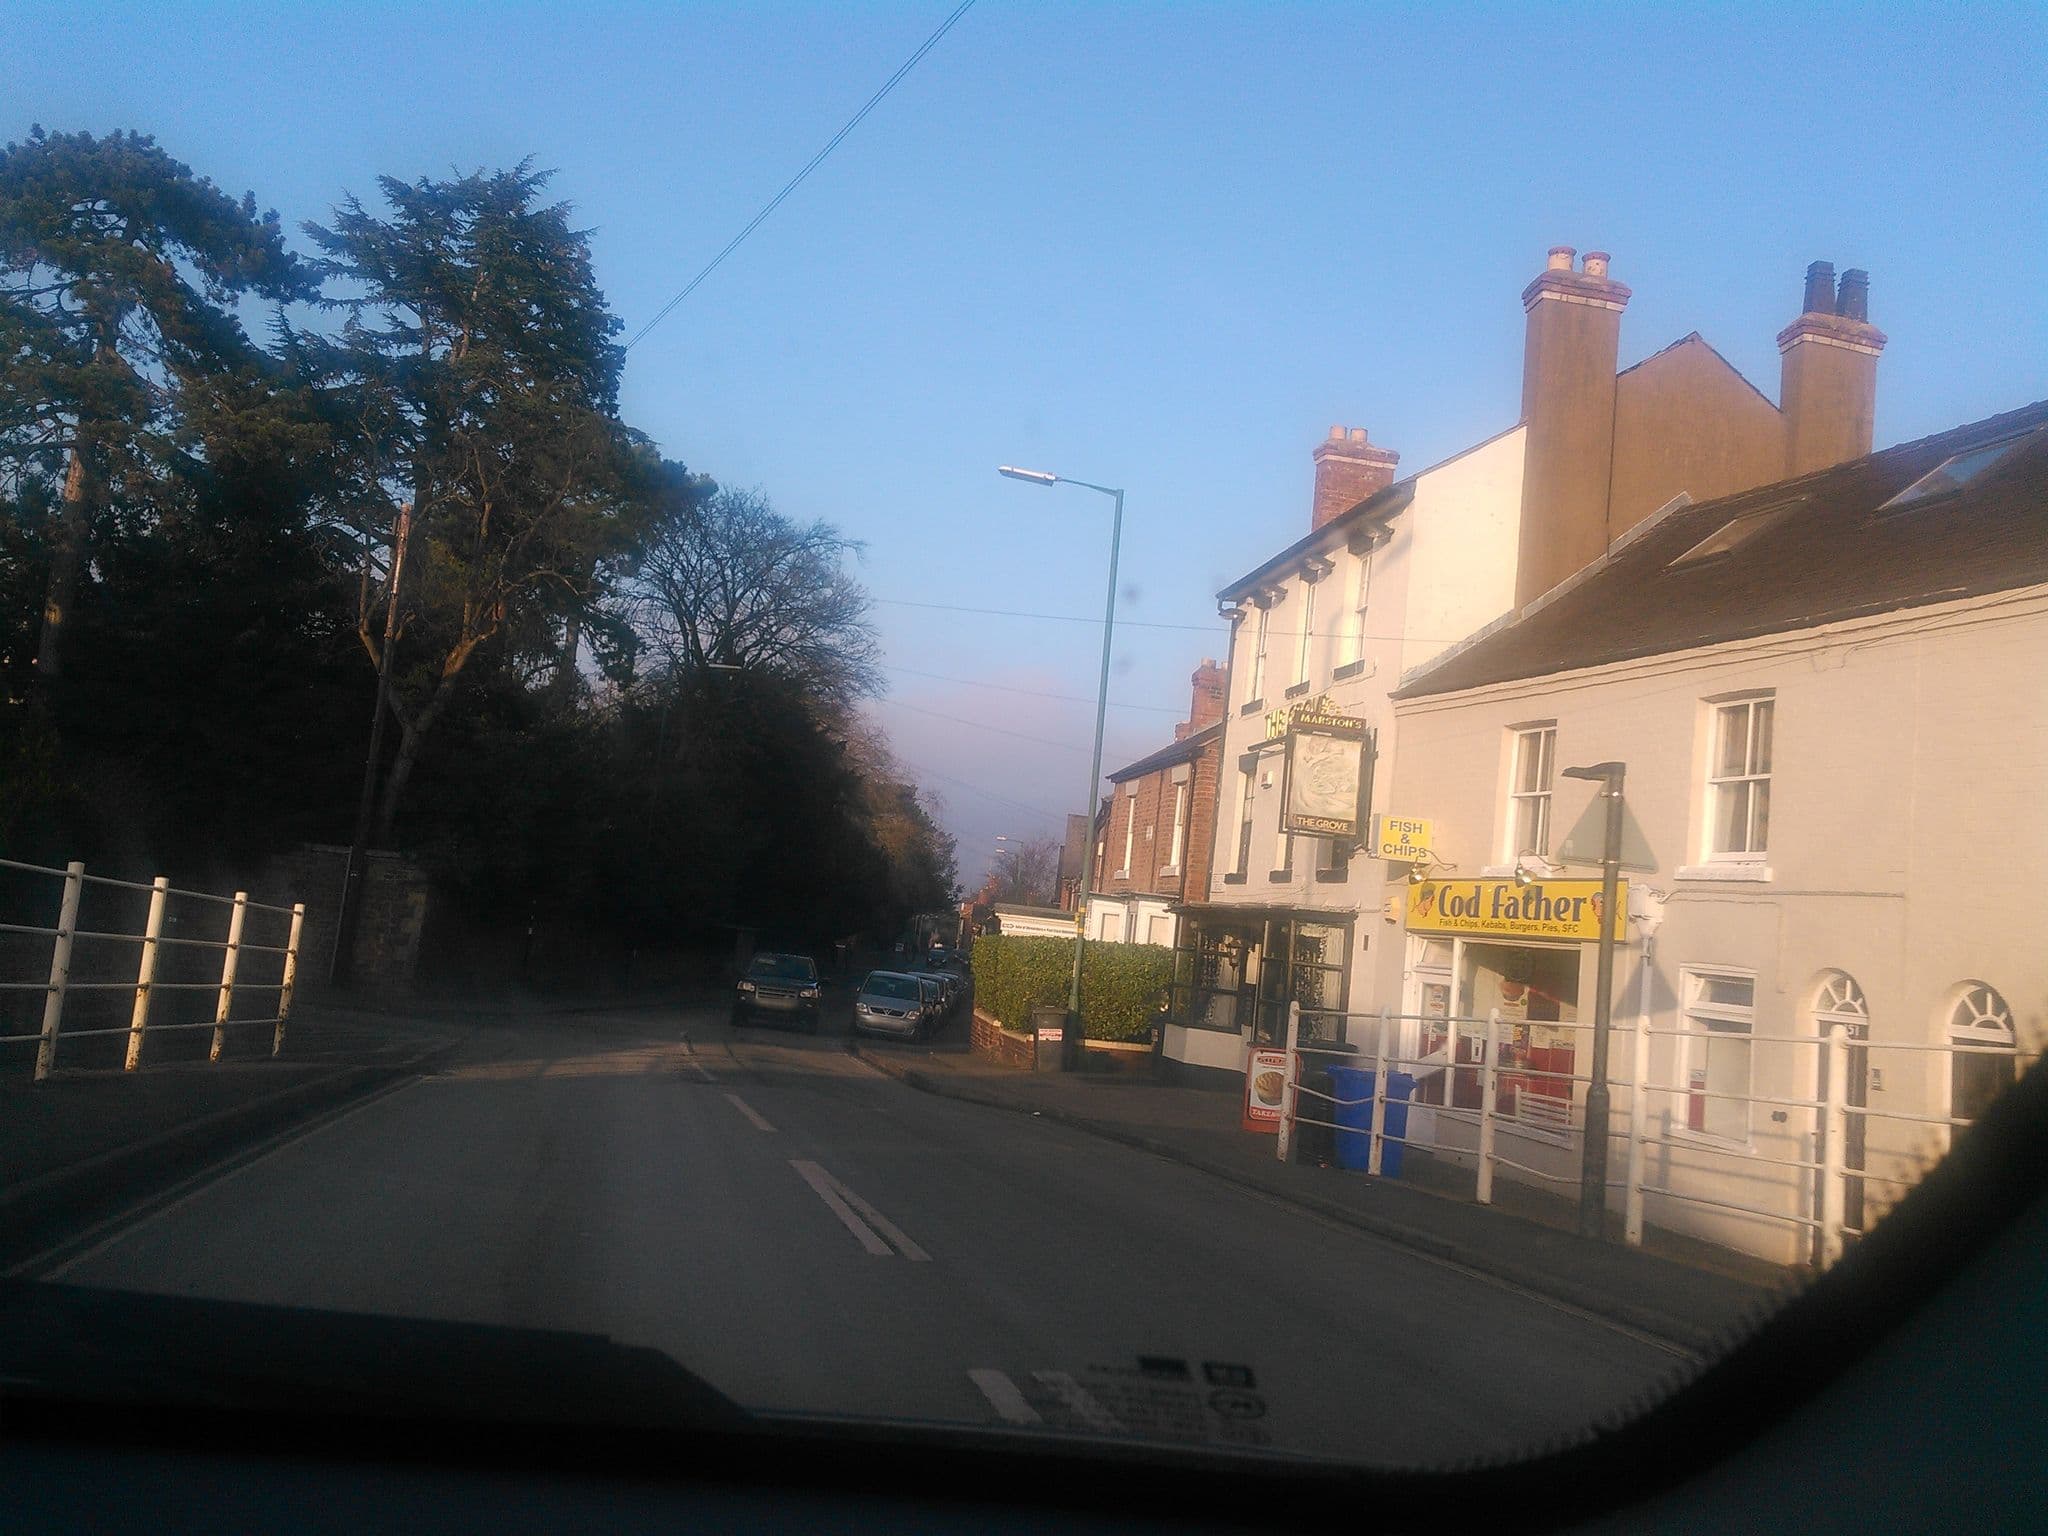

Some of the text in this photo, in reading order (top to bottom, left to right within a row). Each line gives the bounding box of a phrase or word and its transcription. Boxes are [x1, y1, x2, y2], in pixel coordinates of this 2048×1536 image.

[1300, 713, 1362, 729] MARSTON'S
[1298, 818, 1349, 833] THE GROVE
[1390, 820, 1423, 834] FISH
[1400, 834, 1410, 845] &
[1382, 843, 1428, 858] CHIPS
[1438, 884, 1482, 918] Cod
[1439, 918, 1452, 927] Fish
[1453, 919, 1458, 927] &
[1460, 919, 1480, 929] Chips,
[1481, 920, 1507, 930] Kebabs,
[1510, 921, 1540, 932] Burgers,
[1562, 924, 1578, 933] SFC
